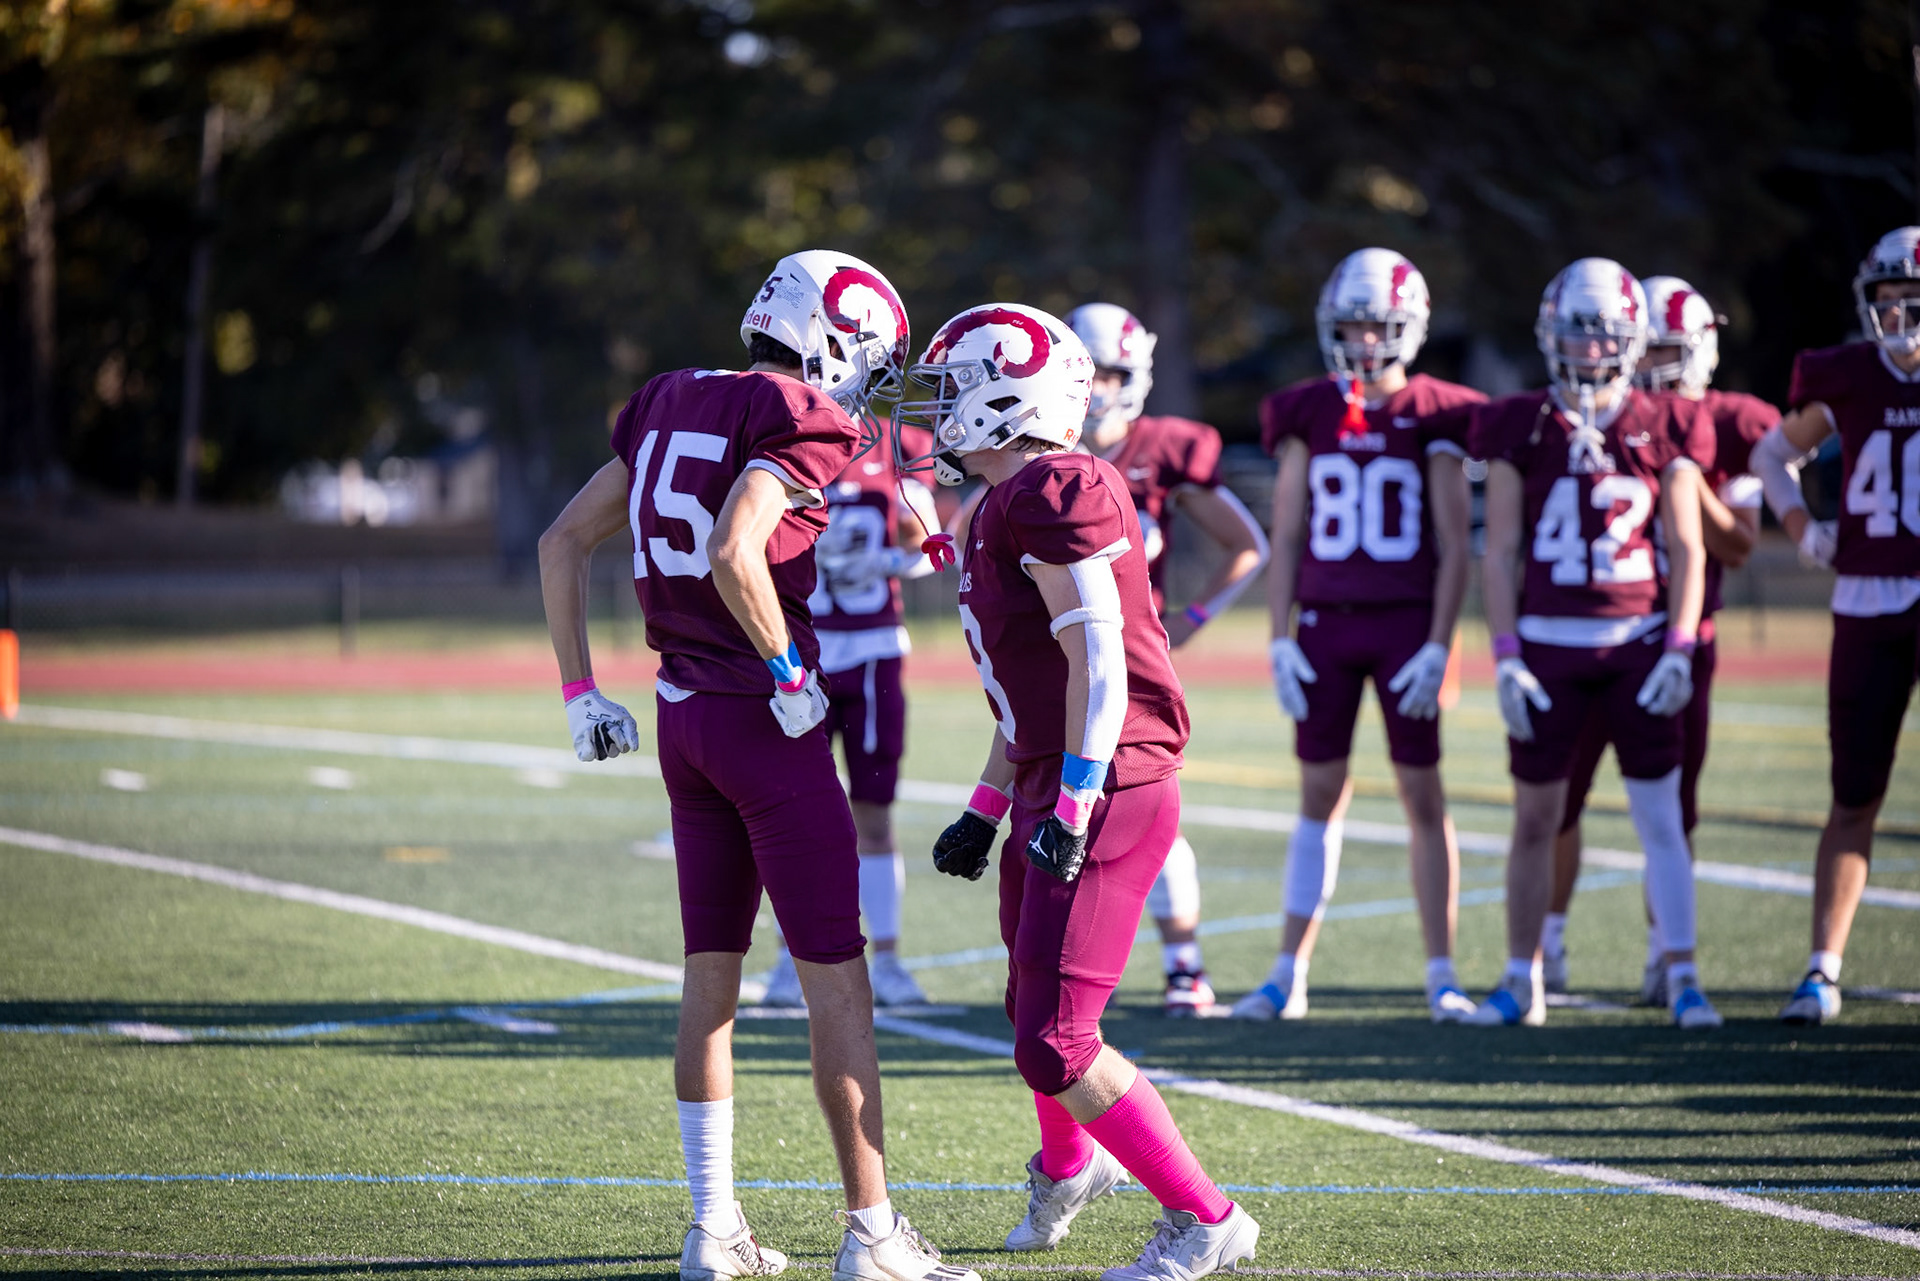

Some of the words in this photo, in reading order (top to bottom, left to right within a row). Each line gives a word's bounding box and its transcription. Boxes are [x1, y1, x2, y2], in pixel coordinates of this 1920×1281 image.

[629, 430, 728, 580] 15
[1309, 453, 1422, 561] 80
[1533, 475, 1654, 585] 42
